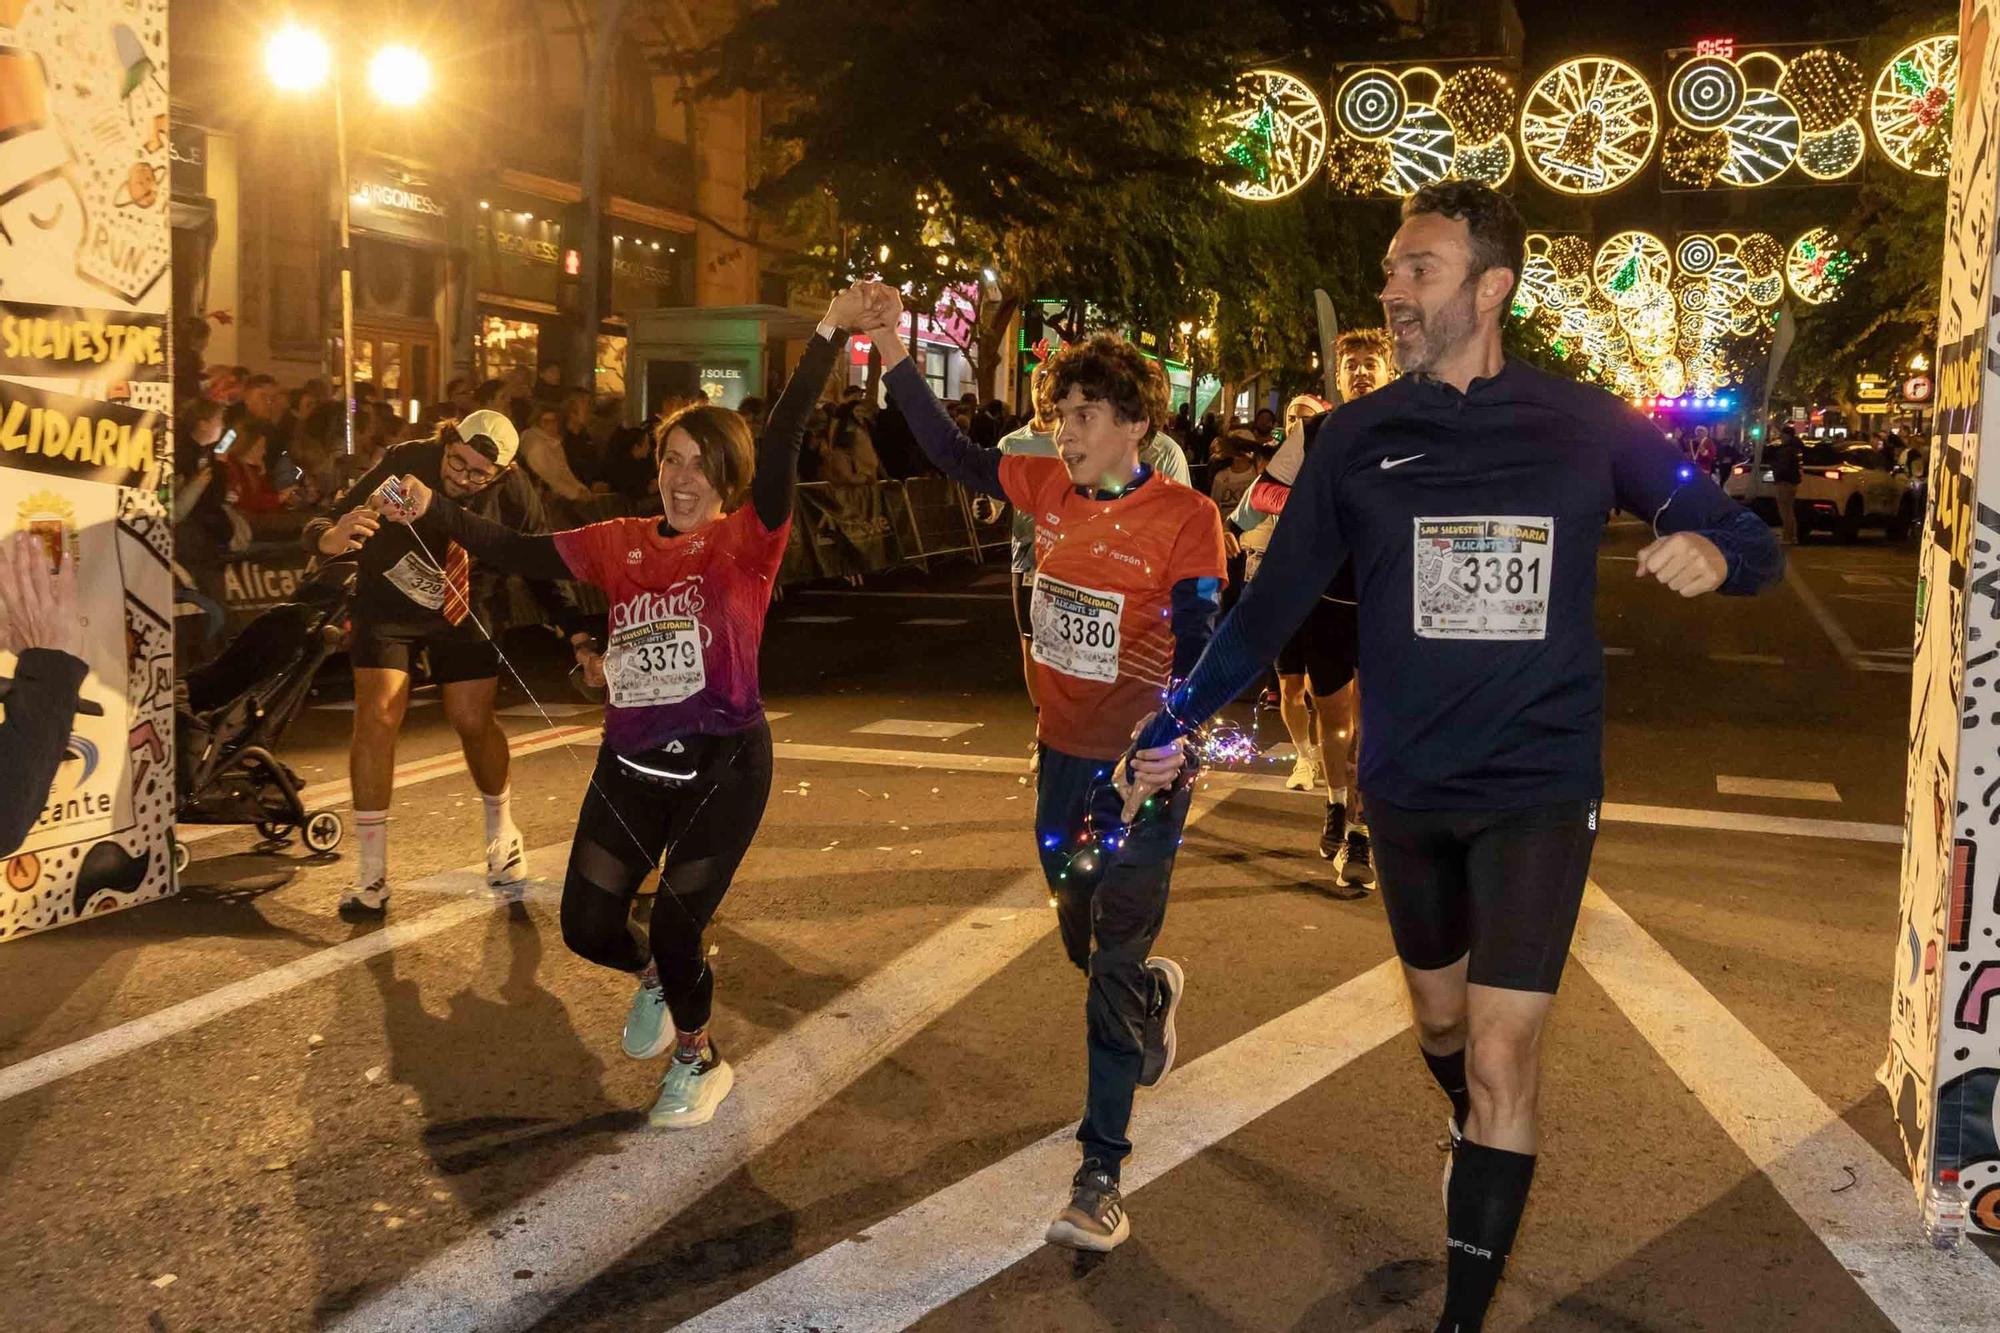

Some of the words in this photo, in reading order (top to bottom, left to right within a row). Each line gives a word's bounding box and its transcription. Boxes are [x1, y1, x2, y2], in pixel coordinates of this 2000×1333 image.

[92, 222, 146, 275] RUN
[2, 315, 165, 366] SILVESTRE
[706, 368, 741, 379] SOLEIL
[0, 400, 155, 473] LIDARIA
[1420, 525, 1439, 535] SAN
[1441, 523, 1485, 536] SILVESTRE
[1492, 524, 1547, 542] SOLIDARIA
[410, 577, 445, 596] 329
[1463, 556, 1541, 594] 3381
[1079, 592, 1118, 613] SOLIDARIA
[1059, 613, 1116, 649] 3380
[637, 640, 696, 673] 3379
